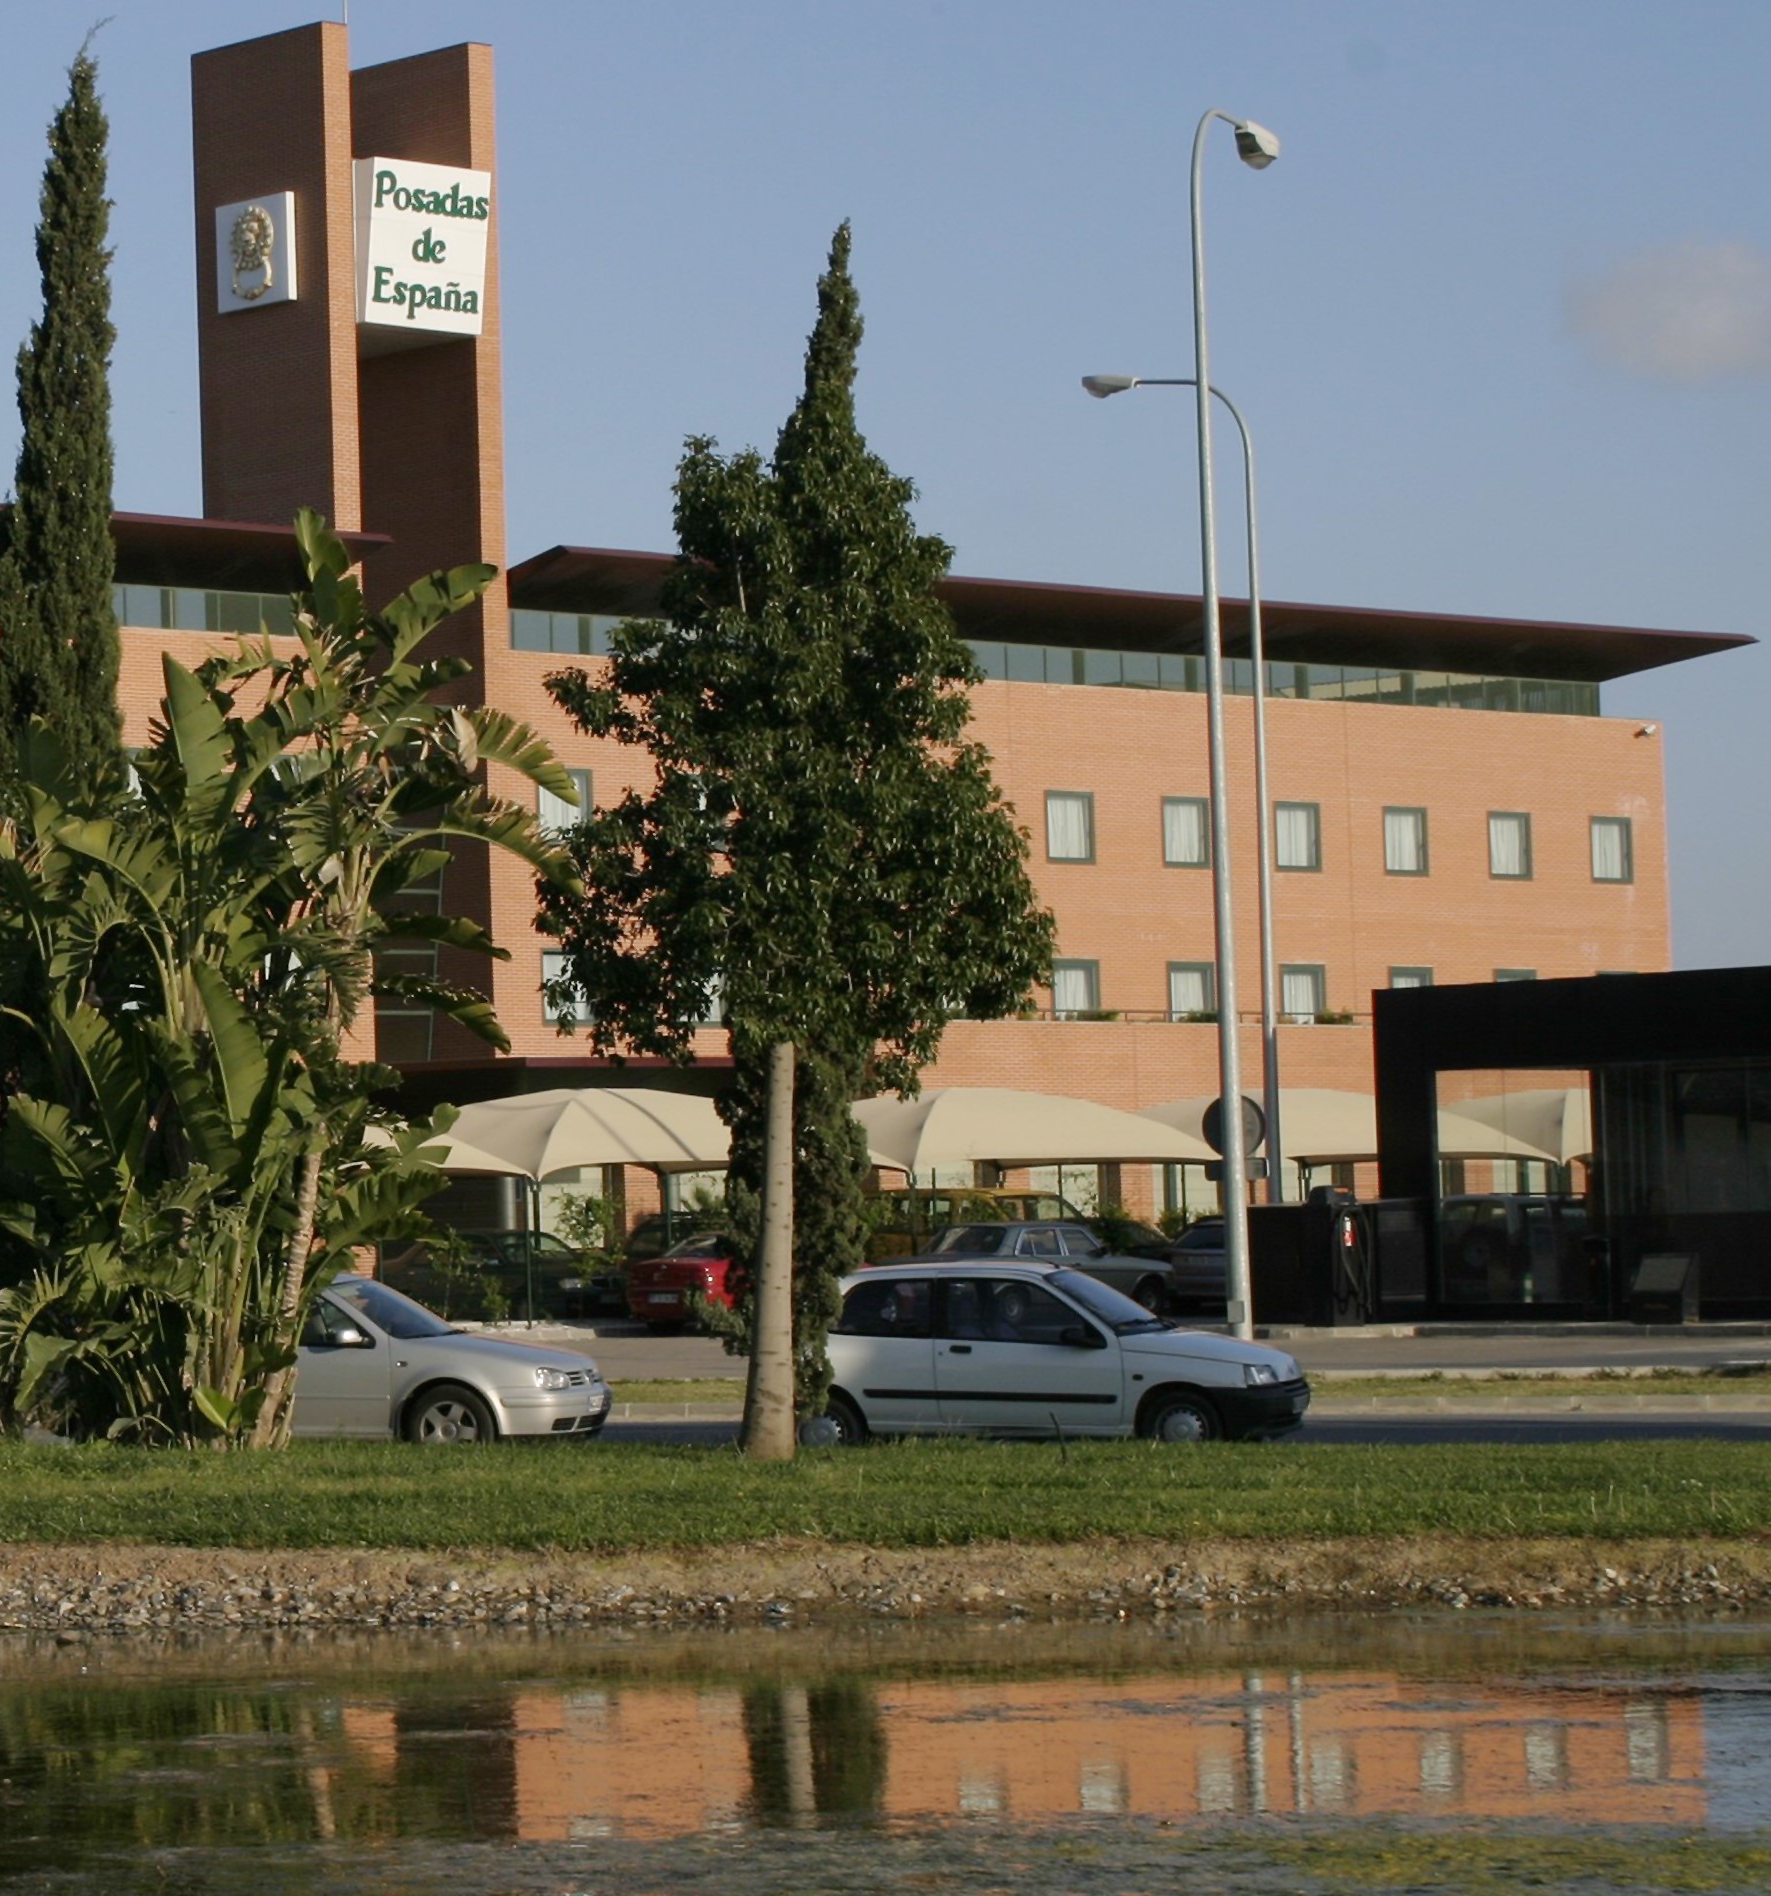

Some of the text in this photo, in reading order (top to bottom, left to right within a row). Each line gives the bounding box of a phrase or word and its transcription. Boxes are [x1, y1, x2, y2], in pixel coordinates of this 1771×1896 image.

[374, 170, 488, 220] Posadas
[412, 227, 446, 264] de
[372, 265, 479, 320] España
